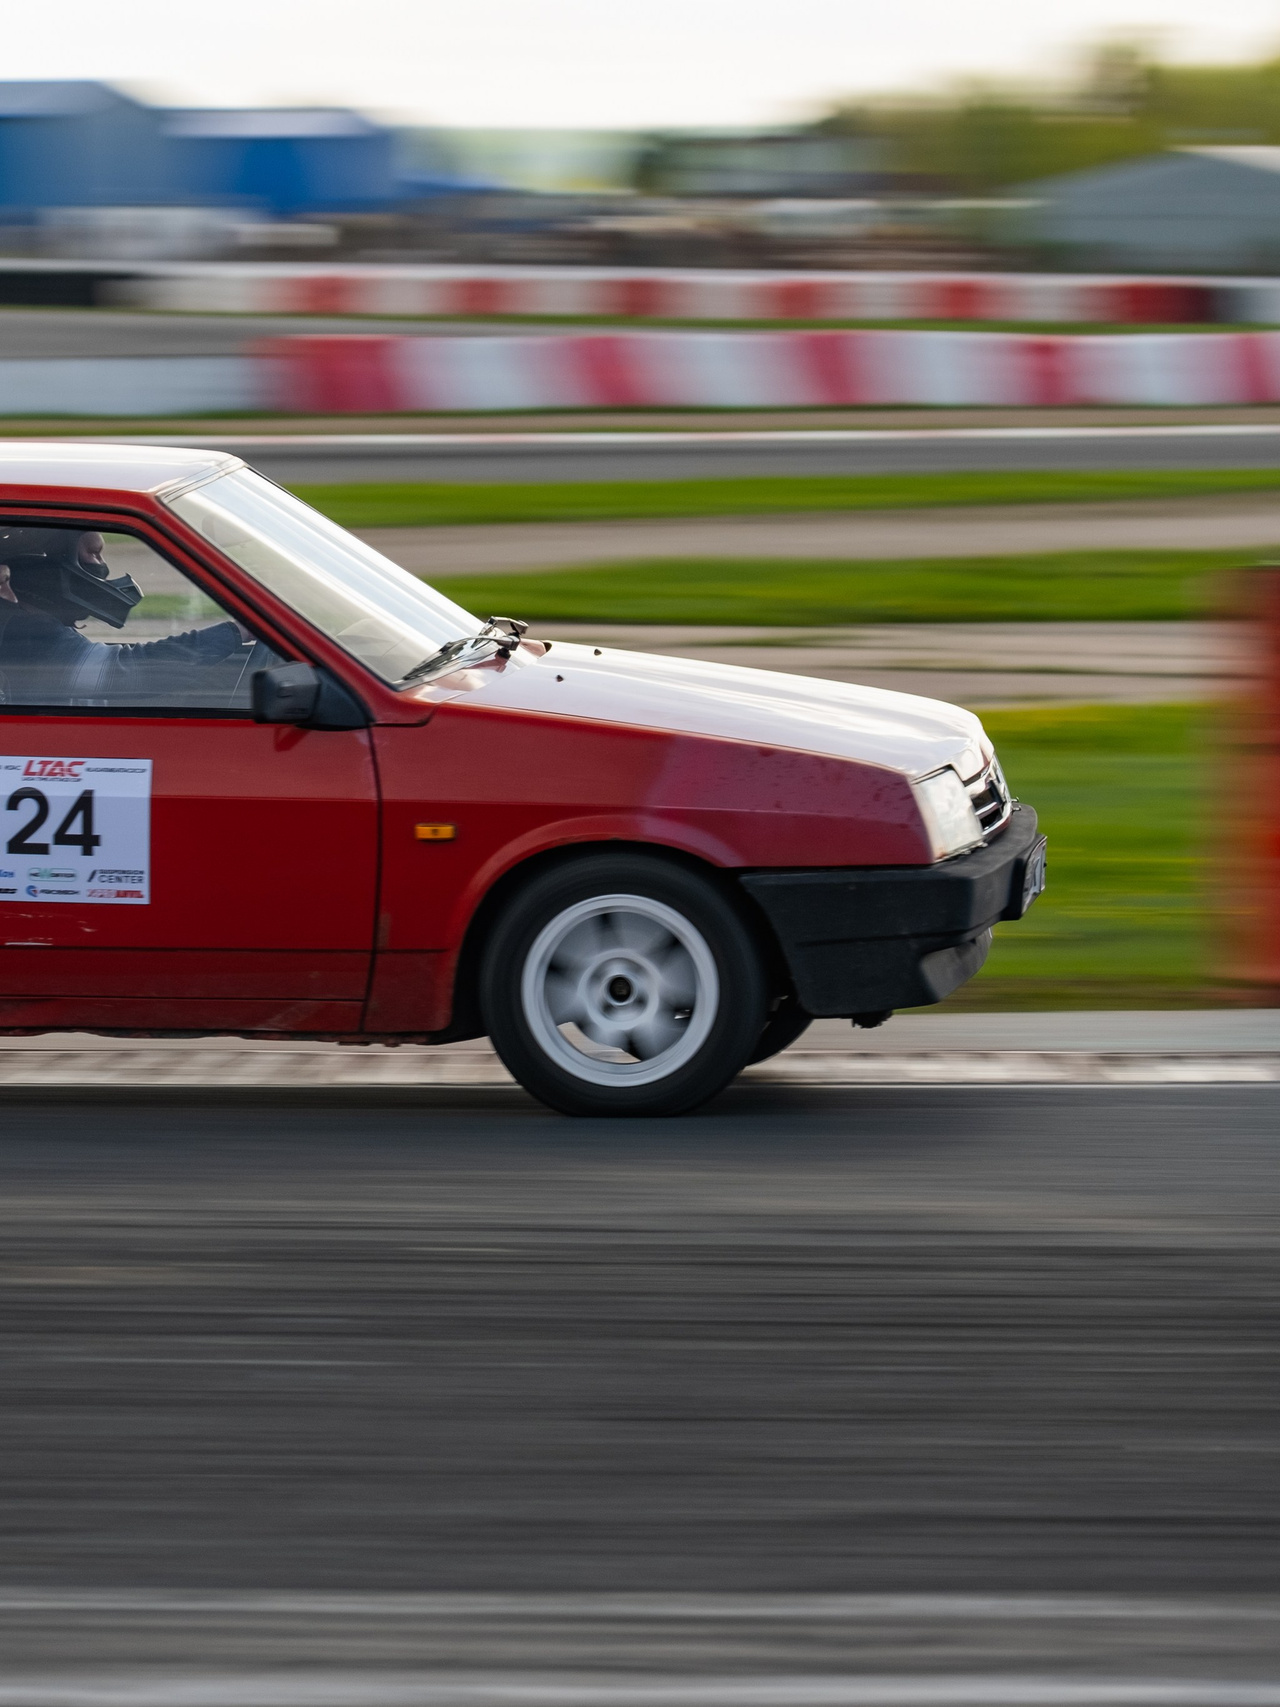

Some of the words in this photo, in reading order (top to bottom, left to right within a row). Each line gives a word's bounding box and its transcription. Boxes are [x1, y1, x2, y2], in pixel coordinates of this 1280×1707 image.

[23, 760, 86, 777] LTAC
[6, 787, 101, 856] 24
[98, 875, 144, 883] CENTER
